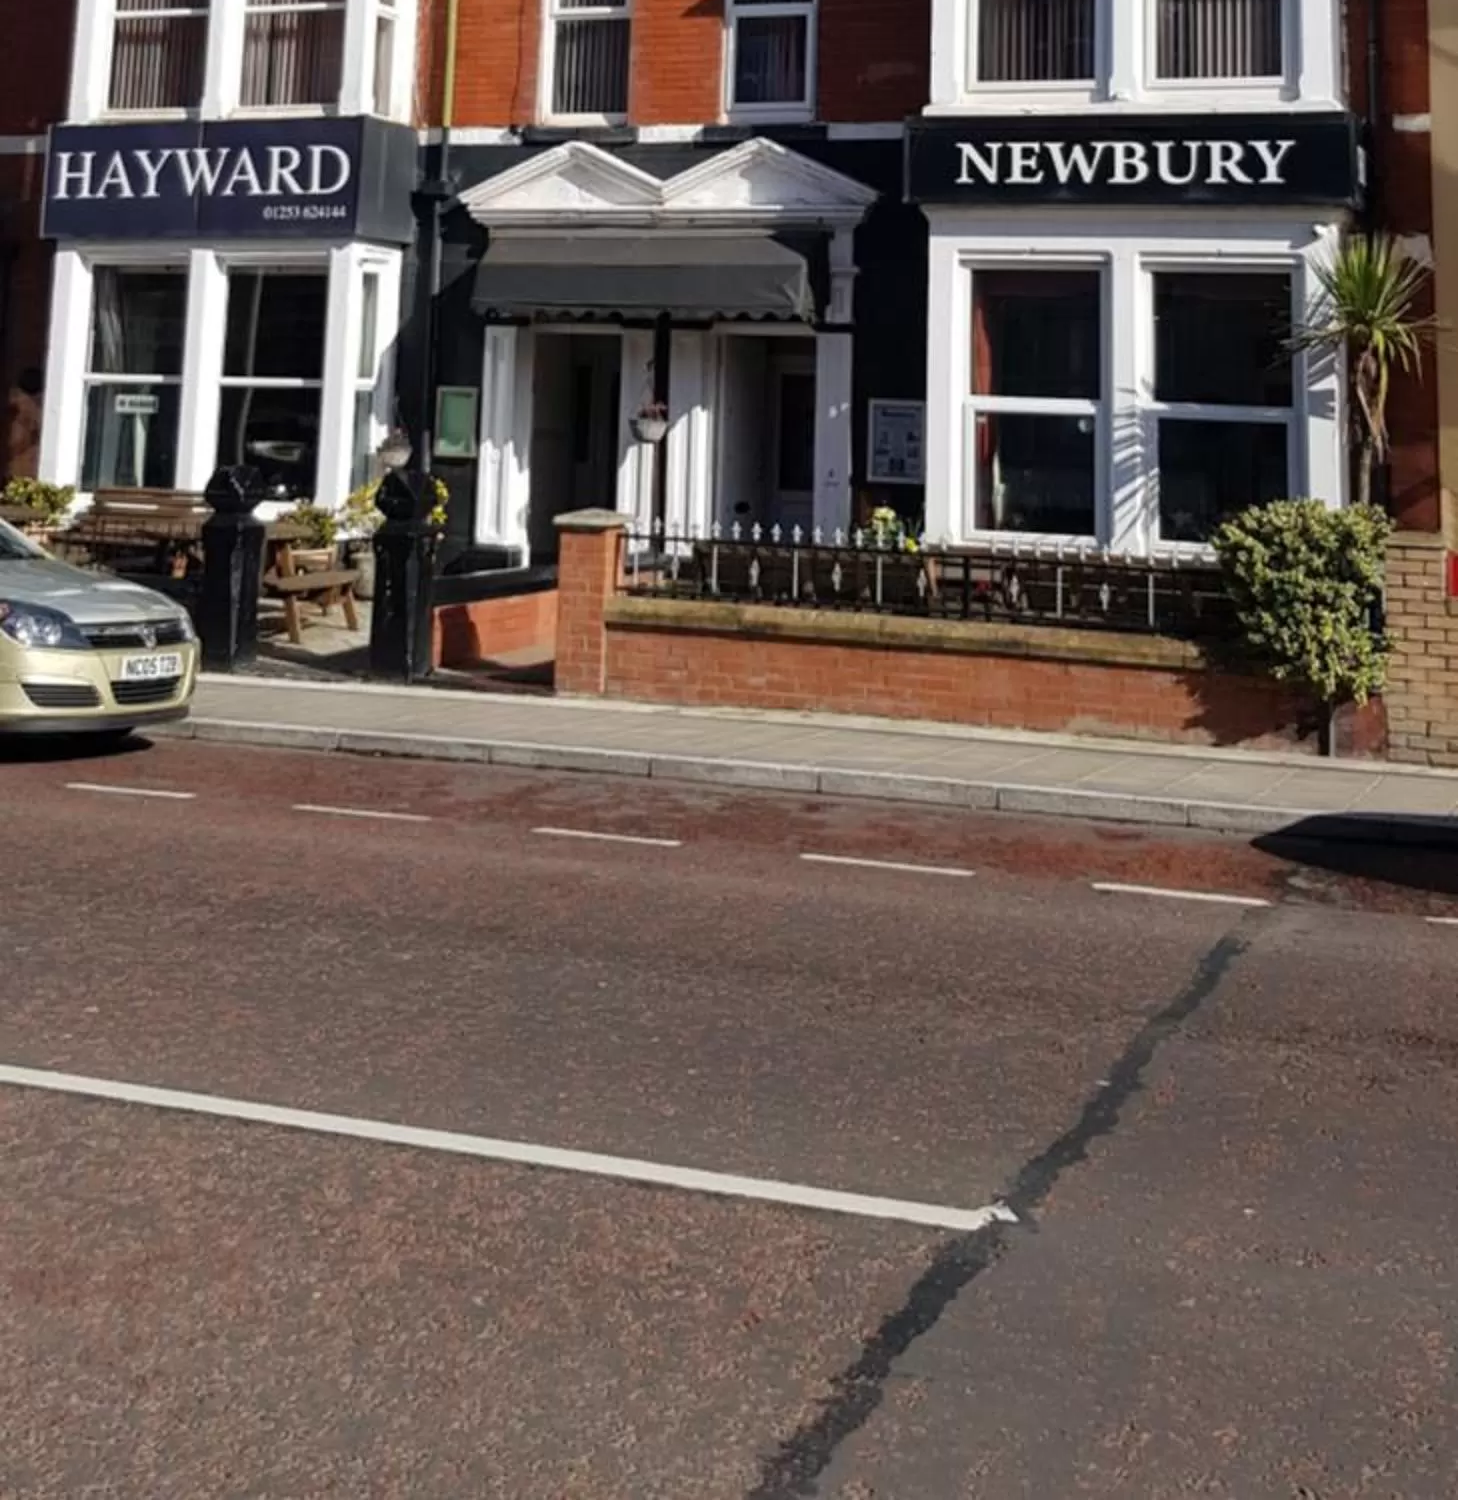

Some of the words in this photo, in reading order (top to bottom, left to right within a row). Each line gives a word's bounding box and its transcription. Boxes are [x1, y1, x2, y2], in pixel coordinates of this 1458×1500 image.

[53, 144, 351, 199] HAYWARD
[954, 140, 1297, 185] NEWBURY
[263, 205, 300, 220] 01253
